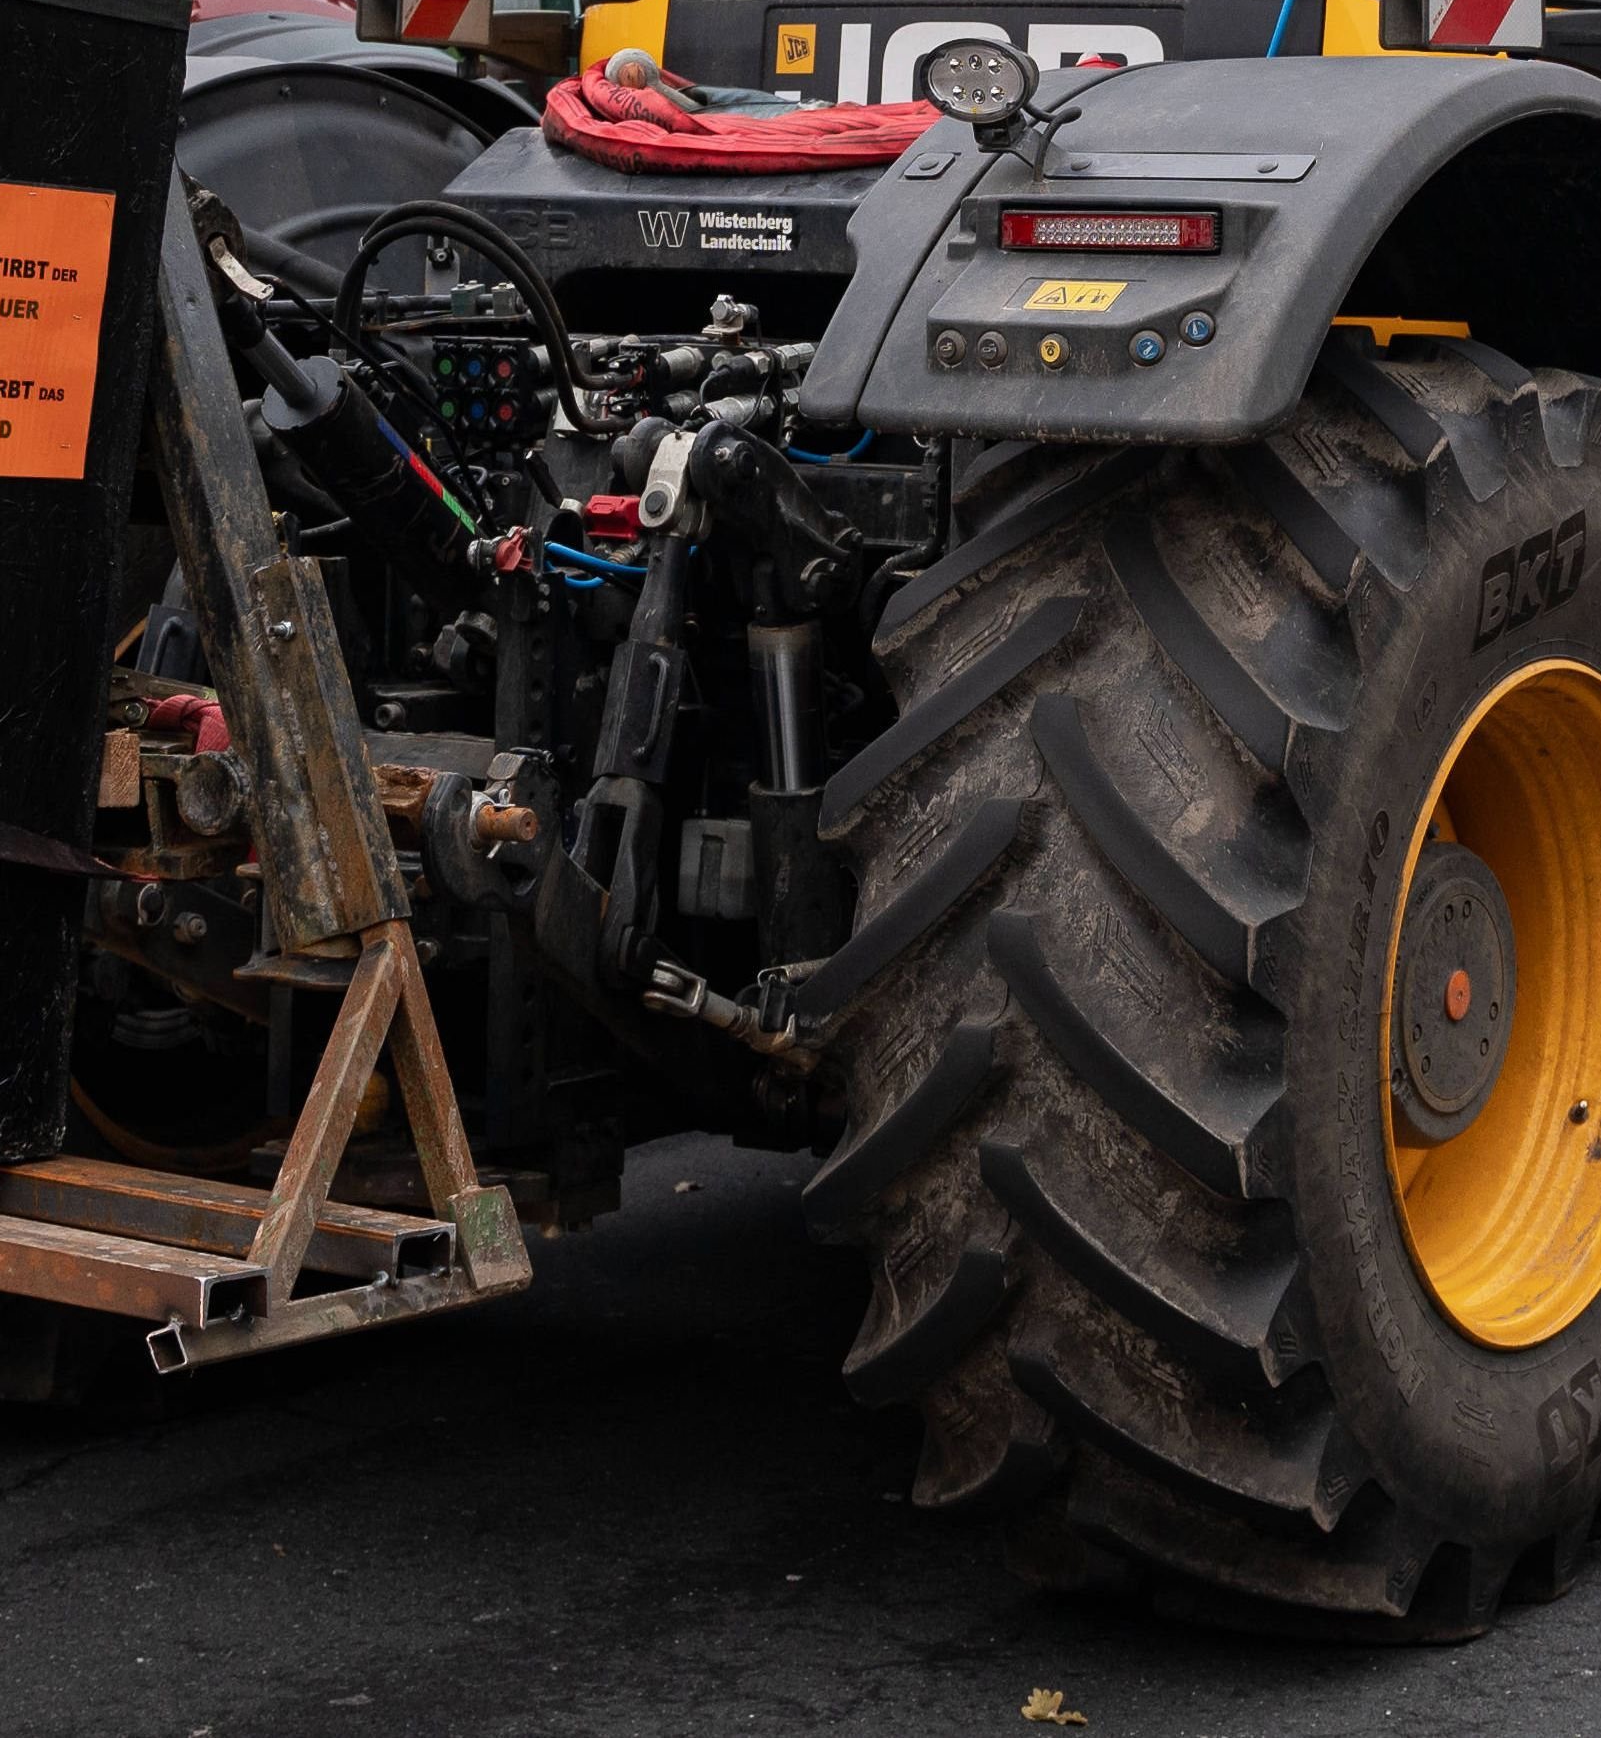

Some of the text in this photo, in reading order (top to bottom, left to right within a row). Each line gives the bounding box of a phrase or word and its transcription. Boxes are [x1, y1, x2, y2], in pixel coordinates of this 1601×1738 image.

[782, 36, 810, 64] JCB
[698, 211, 793, 235] Wüstenberg
[700, 231, 792, 251] Landtechnik
[51, 267, 78, 283] DER
[38, 387, 65, 402] DAS
[1478, 521, 1586, 640] BKT
